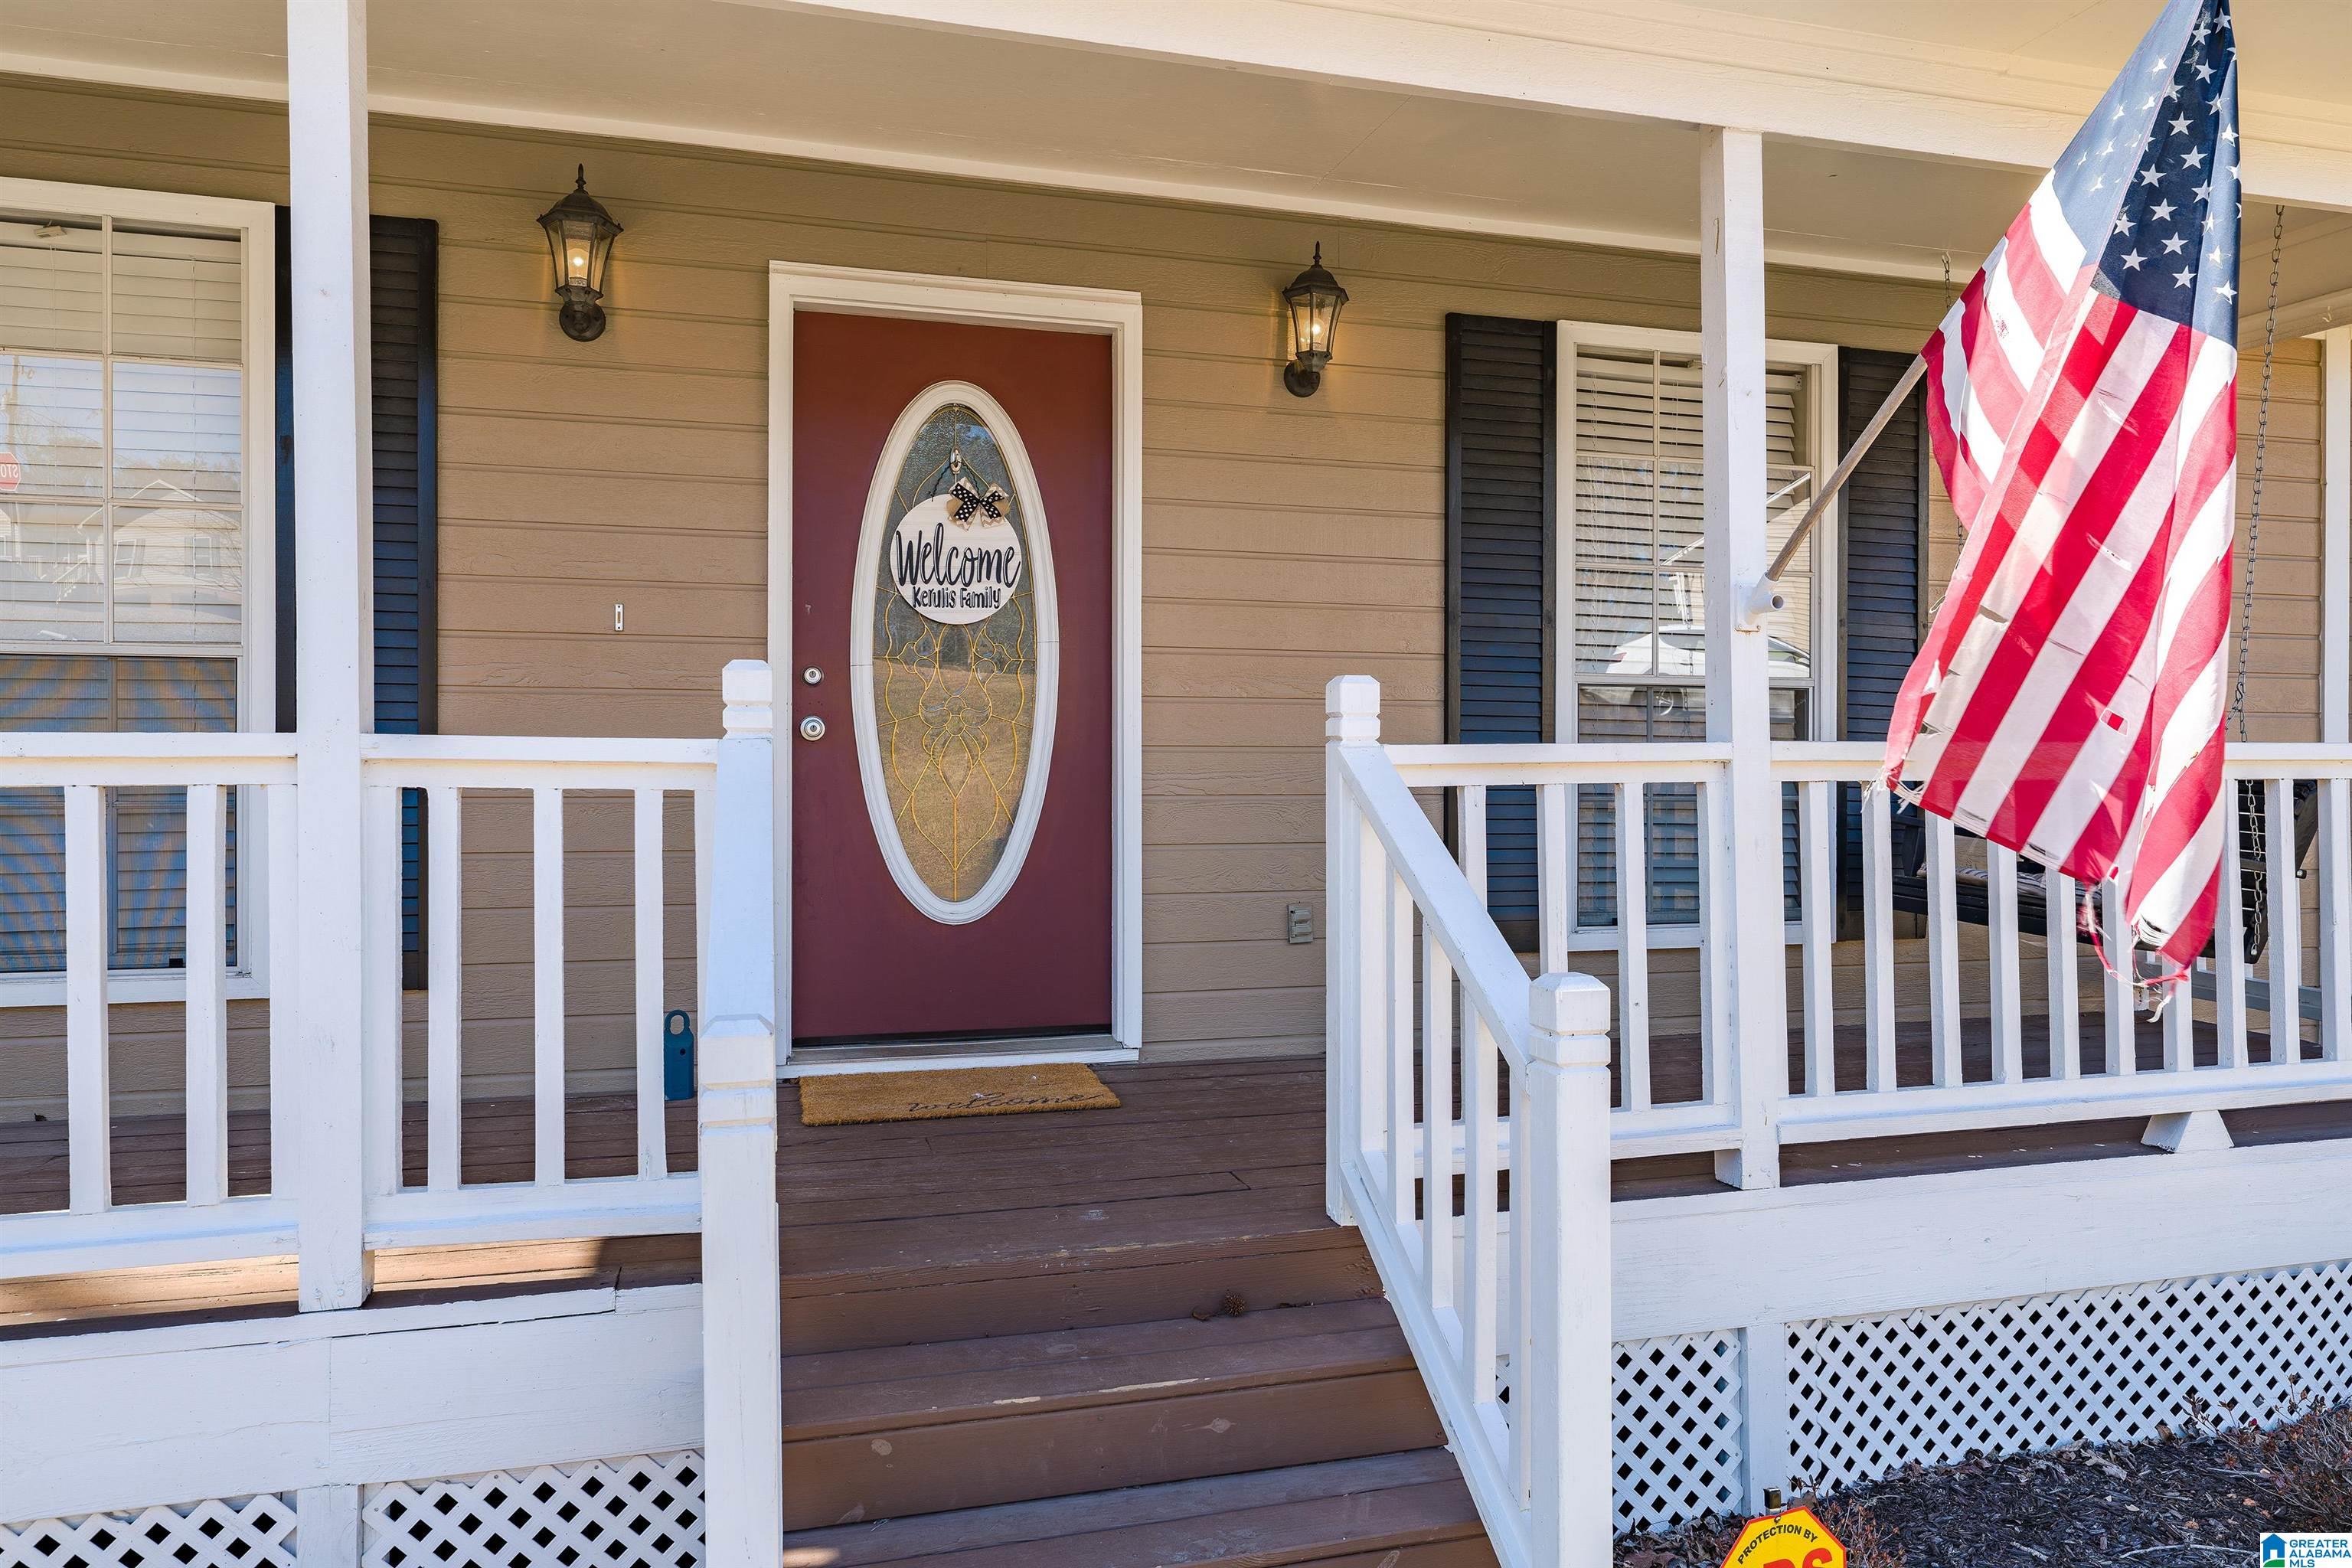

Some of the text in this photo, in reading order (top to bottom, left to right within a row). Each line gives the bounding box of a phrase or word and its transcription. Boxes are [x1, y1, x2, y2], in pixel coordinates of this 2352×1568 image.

[895, 523, 1021, 588] Welcome
[912, 586, 1001, 609] Kerulis Family
[1737, 1524, 1802, 1565] PROTECTION
[1803, 1529, 1818, 1543] BY
